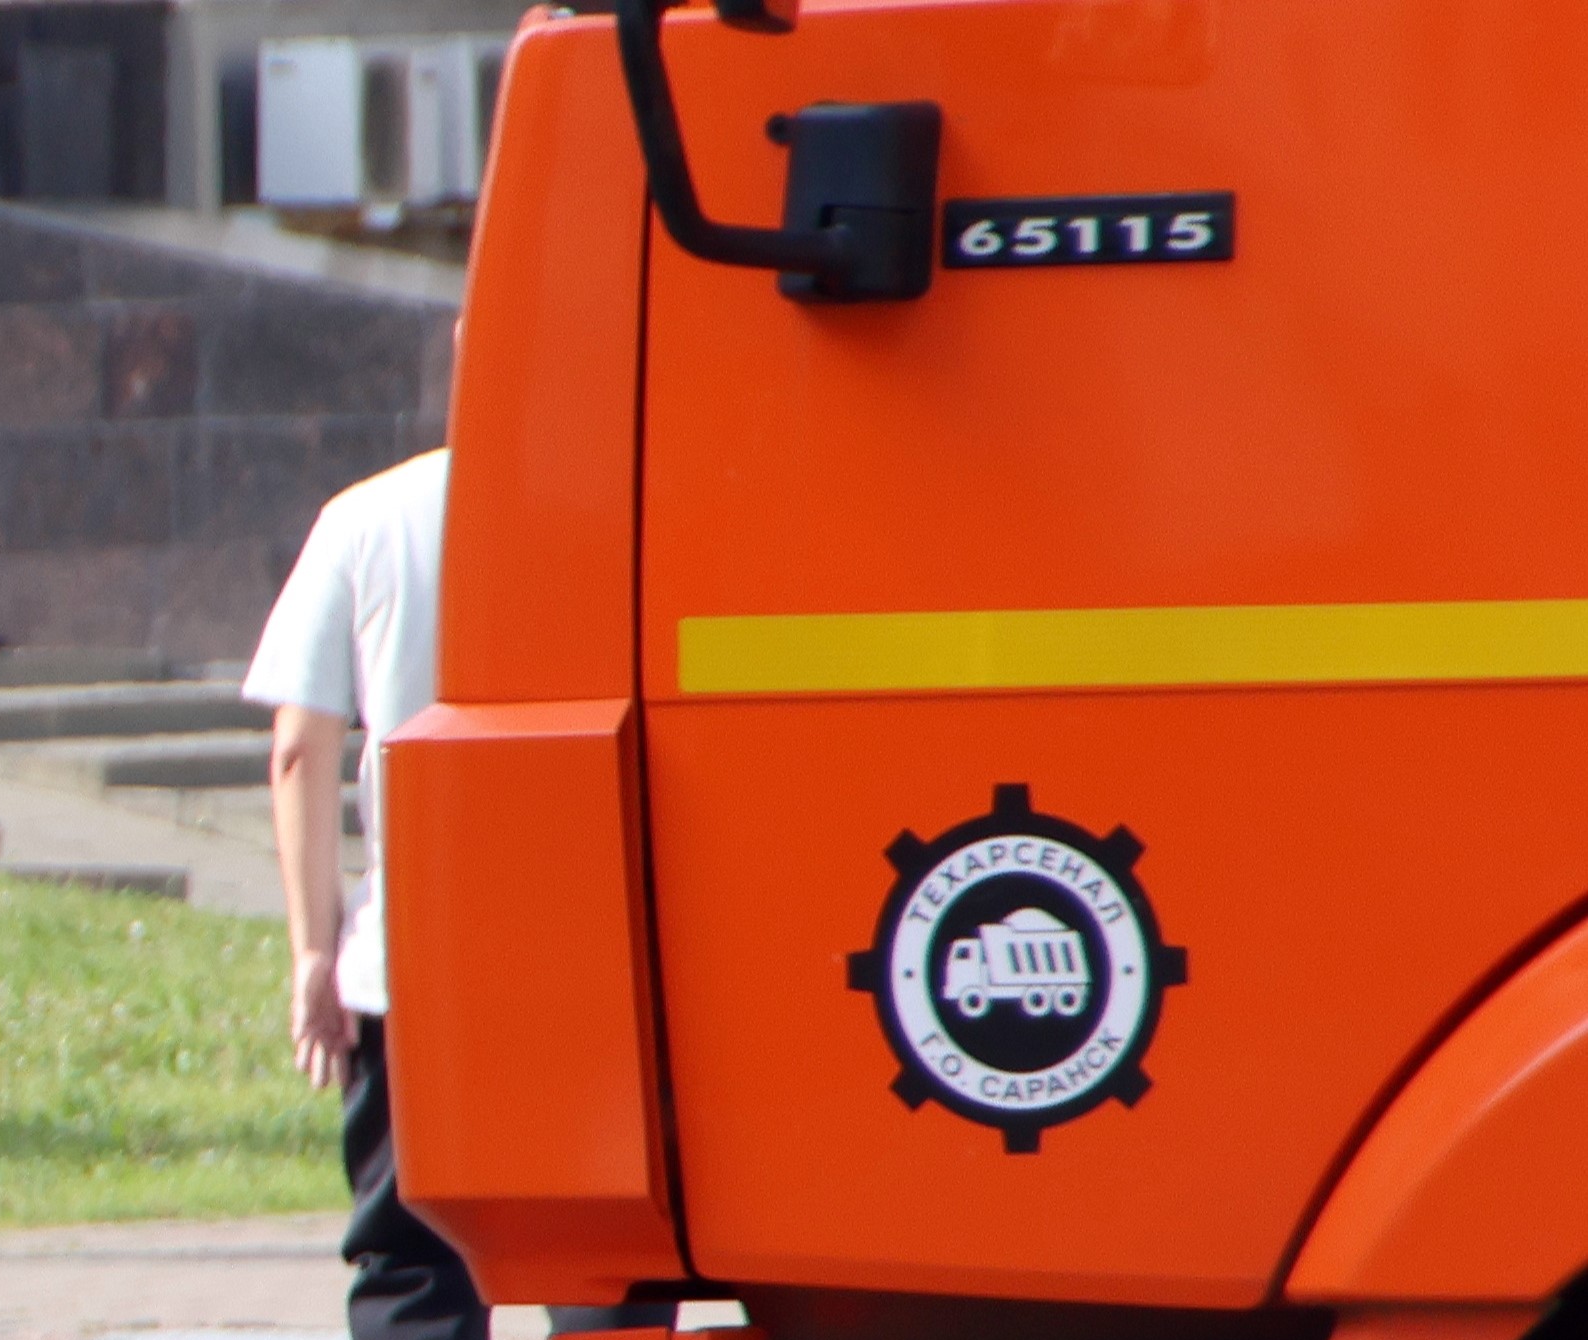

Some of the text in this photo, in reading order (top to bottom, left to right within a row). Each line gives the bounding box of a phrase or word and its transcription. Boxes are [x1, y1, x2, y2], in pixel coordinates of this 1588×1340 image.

[957, 211, 1216, 257] 65115
[909, 842, 1126, 925] ТЕХАРСЕНАЛ
[979, 1029, 1124, 1101] САРАНСК
